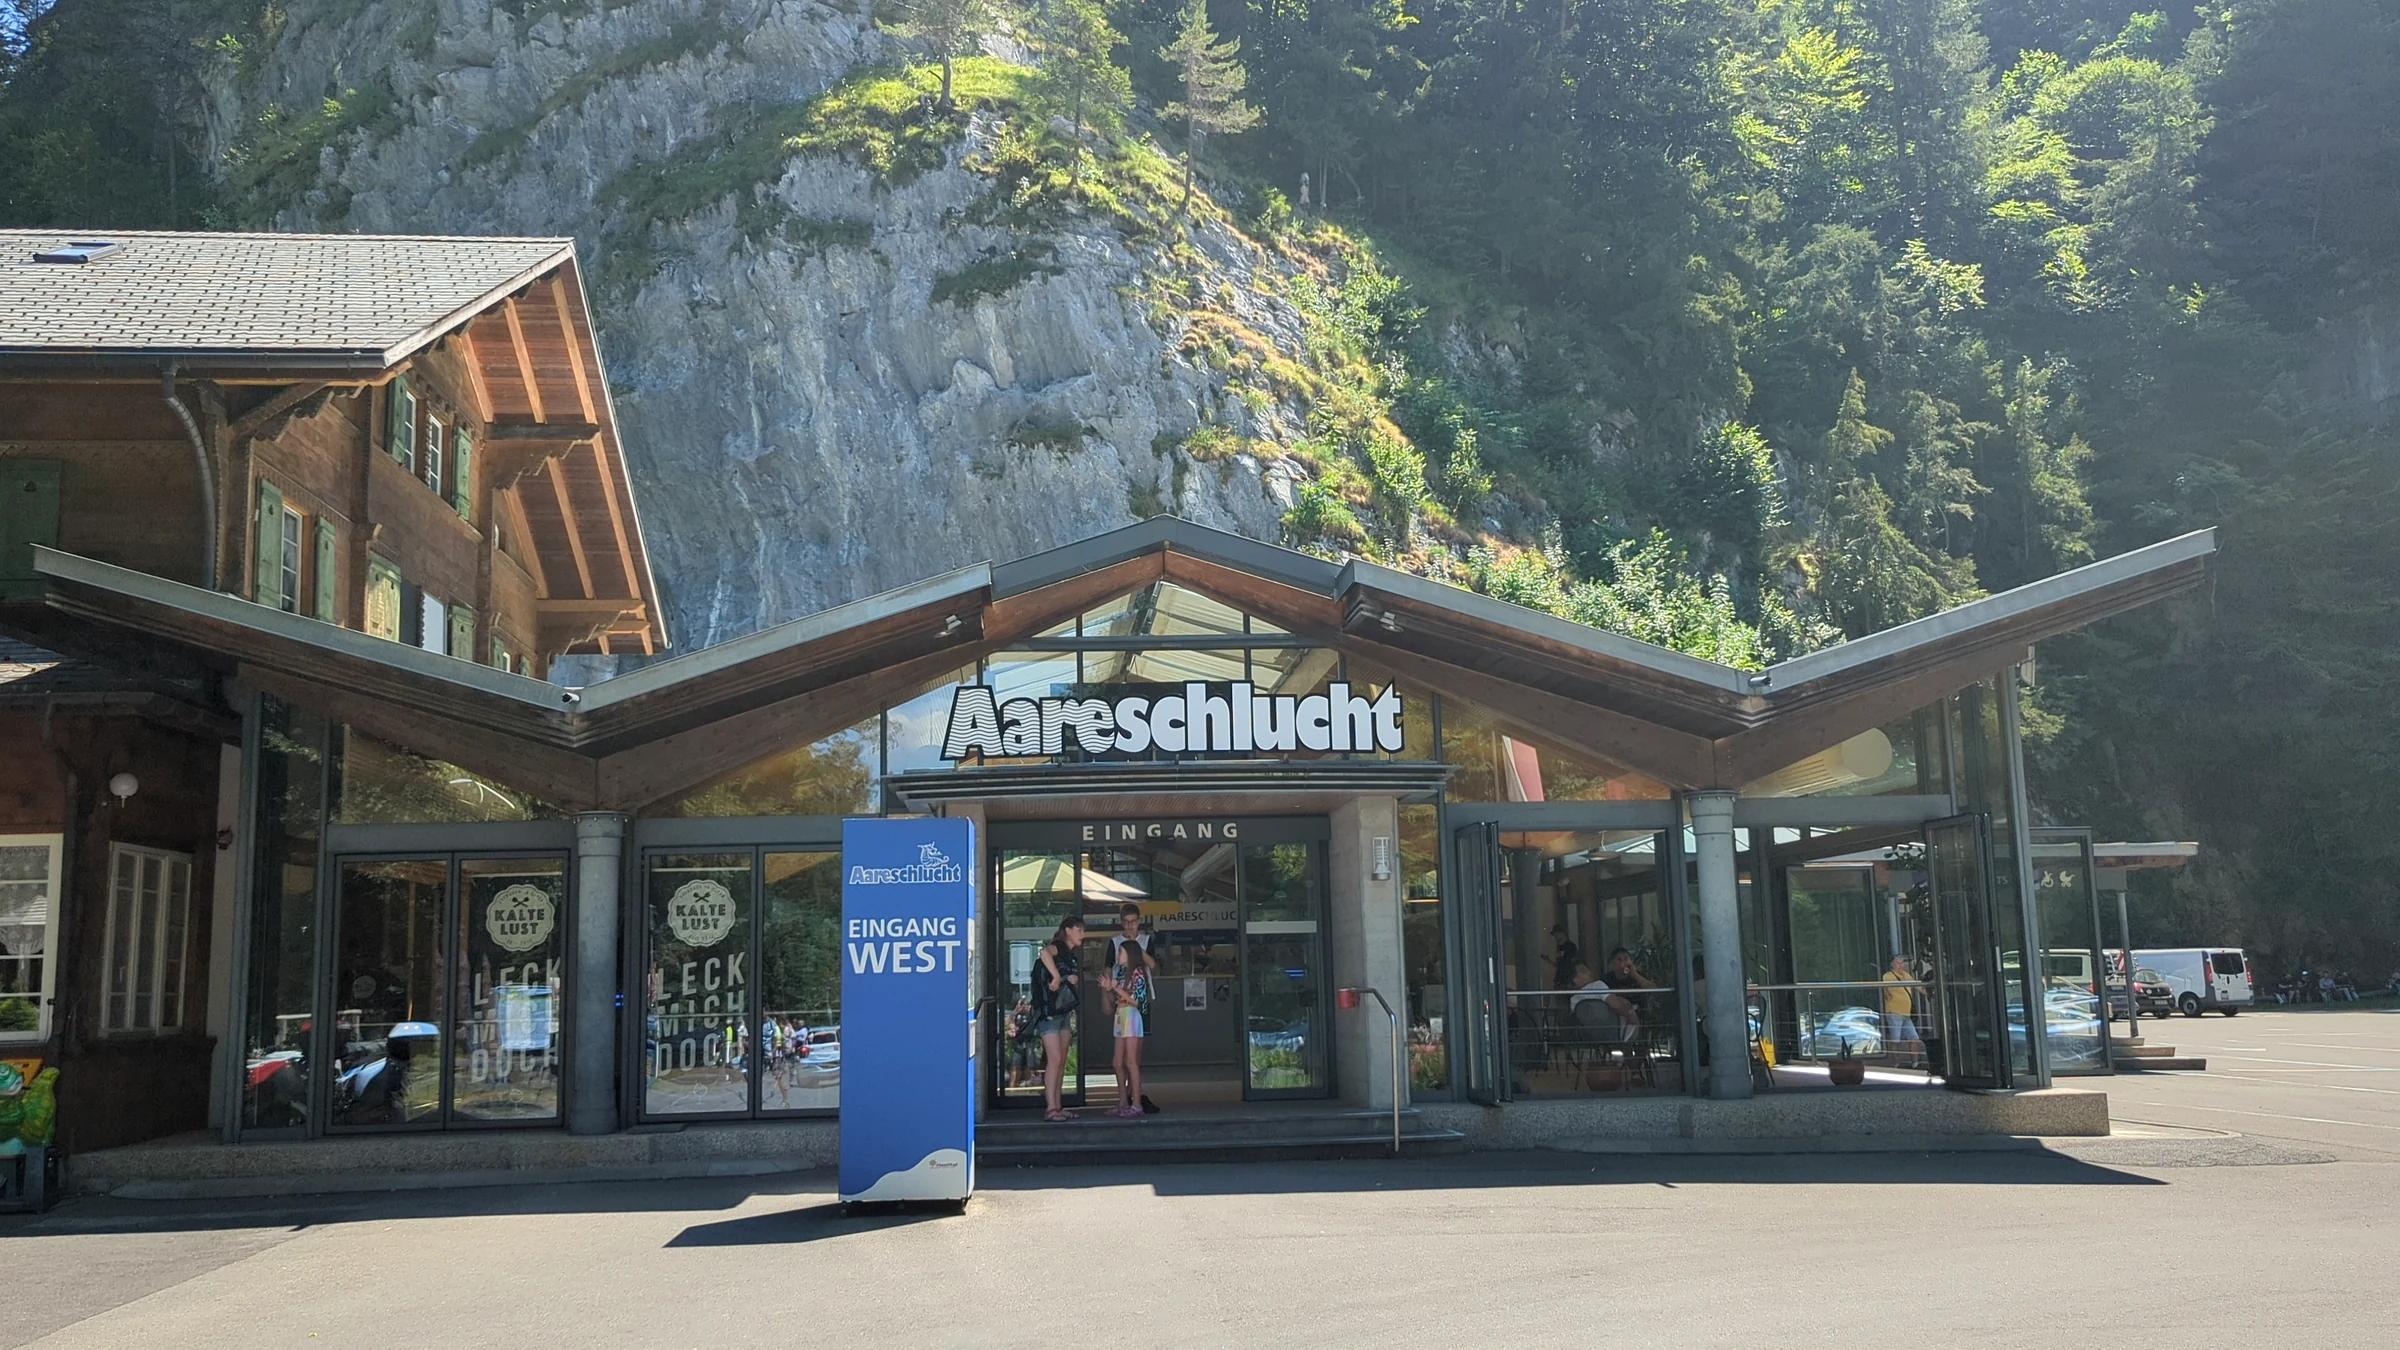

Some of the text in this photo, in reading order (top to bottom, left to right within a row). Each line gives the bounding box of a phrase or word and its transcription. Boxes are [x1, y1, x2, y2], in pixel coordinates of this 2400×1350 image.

[940, 677, 1405, 760] Aareschlucht
[1082, 823, 1238, 841] EINGANG
[849, 863, 961, 885] Aareschlucht
[494, 909, 545, 921] KALTE
[676, 904, 726, 917] KALTE
[500, 922, 539, 935] LUST
[682, 918, 720, 930] LUST
[848, 917, 956, 938] EINGANG
[848, 940, 961, 974] WEST
[656, 952, 745, 1001] LECK
[473, 992, 559, 1044] MC
[657, 990, 745, 1038] MICH
[658, 1026, 743, 1076] DOC
